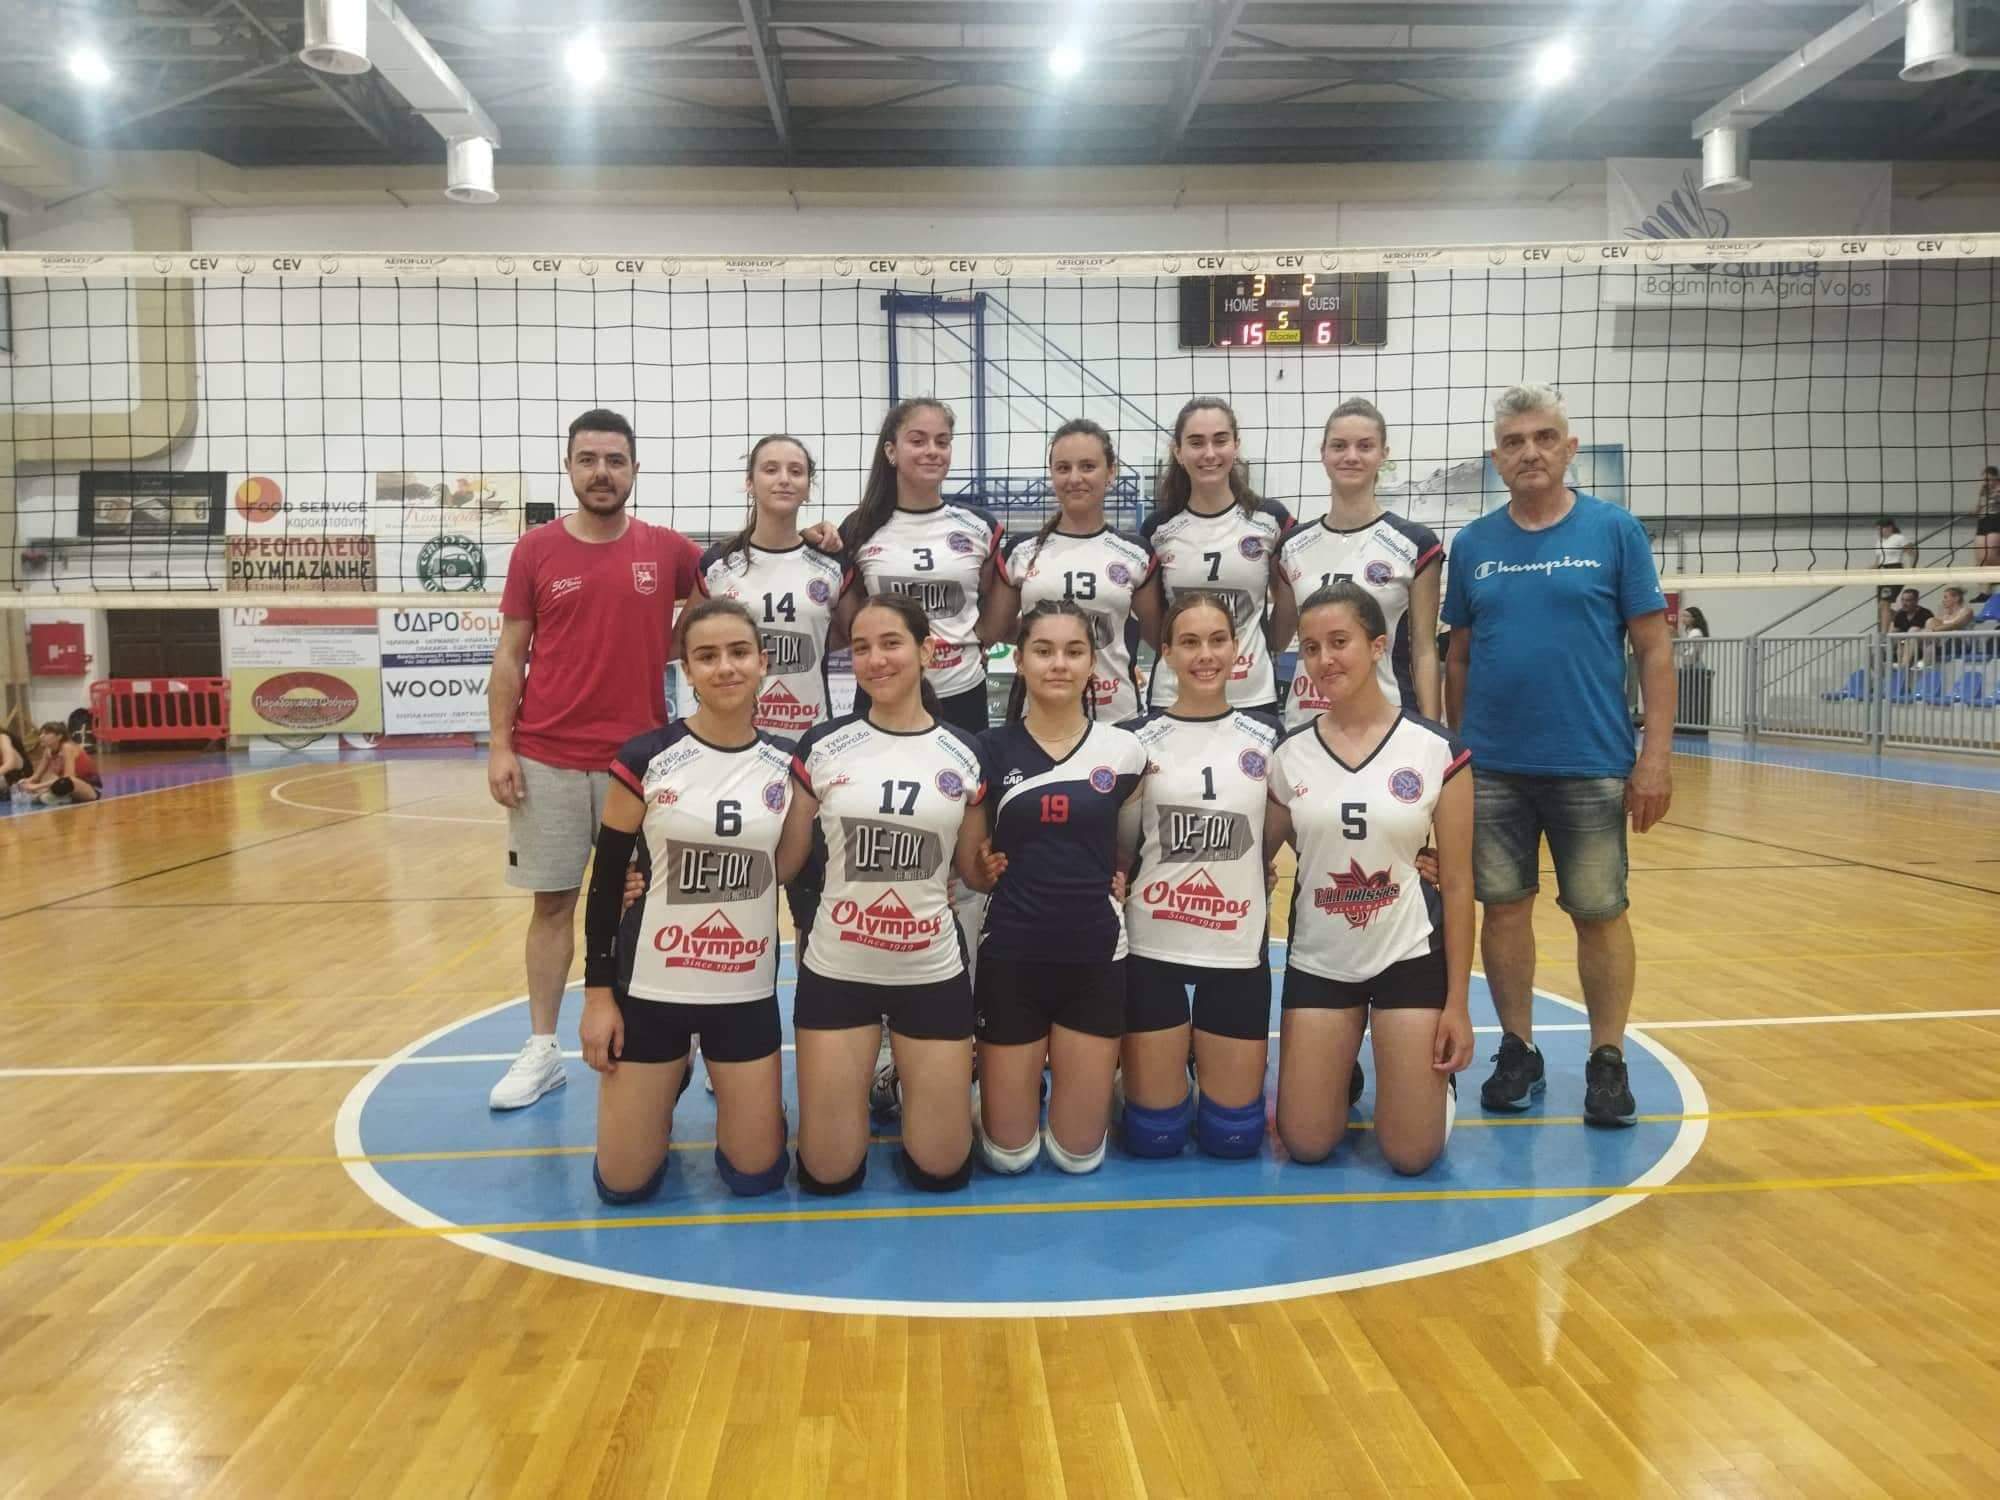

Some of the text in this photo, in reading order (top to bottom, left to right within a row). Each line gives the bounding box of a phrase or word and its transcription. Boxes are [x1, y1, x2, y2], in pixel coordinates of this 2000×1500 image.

[1523, 248, 1550, 261] CEV
[1601, 246, 1629, 260] CEV
[1841, 241, 1867, 254] CEV
[1917, 240, 1943, 253] CEV
[189, 257, 219, 271] CEV
[272, 257, 302, 271] CEV
[532, 259, 562, 272] CEV
[615, 260, 644, 273] CEV
[869, 260, 897, 273] CEV
[949, 259, 977, 273] CEV
[1196, 256, 1225, 270] CEV
[1276, 254, 1304, 268] CEV
[1252, 275, 1315, 296] 3 2
[1645, 276, 1872, 299] Badminton Agria Volos
[1224, 296, 1340, 313] HOME GUEST
[1277, 311, 1289, 330] 5
[1242, 321, 1331, 345] 15 6
[300, 501, 368, 513] SERVICE
[231, 537, 370, 557] ΚΡΕΟΠΩΛΕΙΟ
[912, 548, 935, 571] 3
[1203, 551, 1222, 582] 7
[1474, 555, 1602, 580] Champion
[231, 560, 371, 580] ΡΟΥΜΠΑΖΑΝΗΣ
[1063, 571, 1096, 600] 13
[762, 592, 796, 623] 14
[1003, 775, 1024, 786] CAP
[1201, 766, 1217, 800] 1
[879, 778, 921, 816] 17
[1040, 794, 1069, 823] 19
[715, 800, 743, 837] 6
[1341, 803, 1367, 841] 5
[1143, 880, 1250, 918] Olympos
[831, 900, 942, 939] Olympos
[1168, 911, 1222, 930] Since 1949
[654, 925, 769, 959] Olympos
[856, 935, 886, 948] Since
[683, 958, 714, 969] Since
